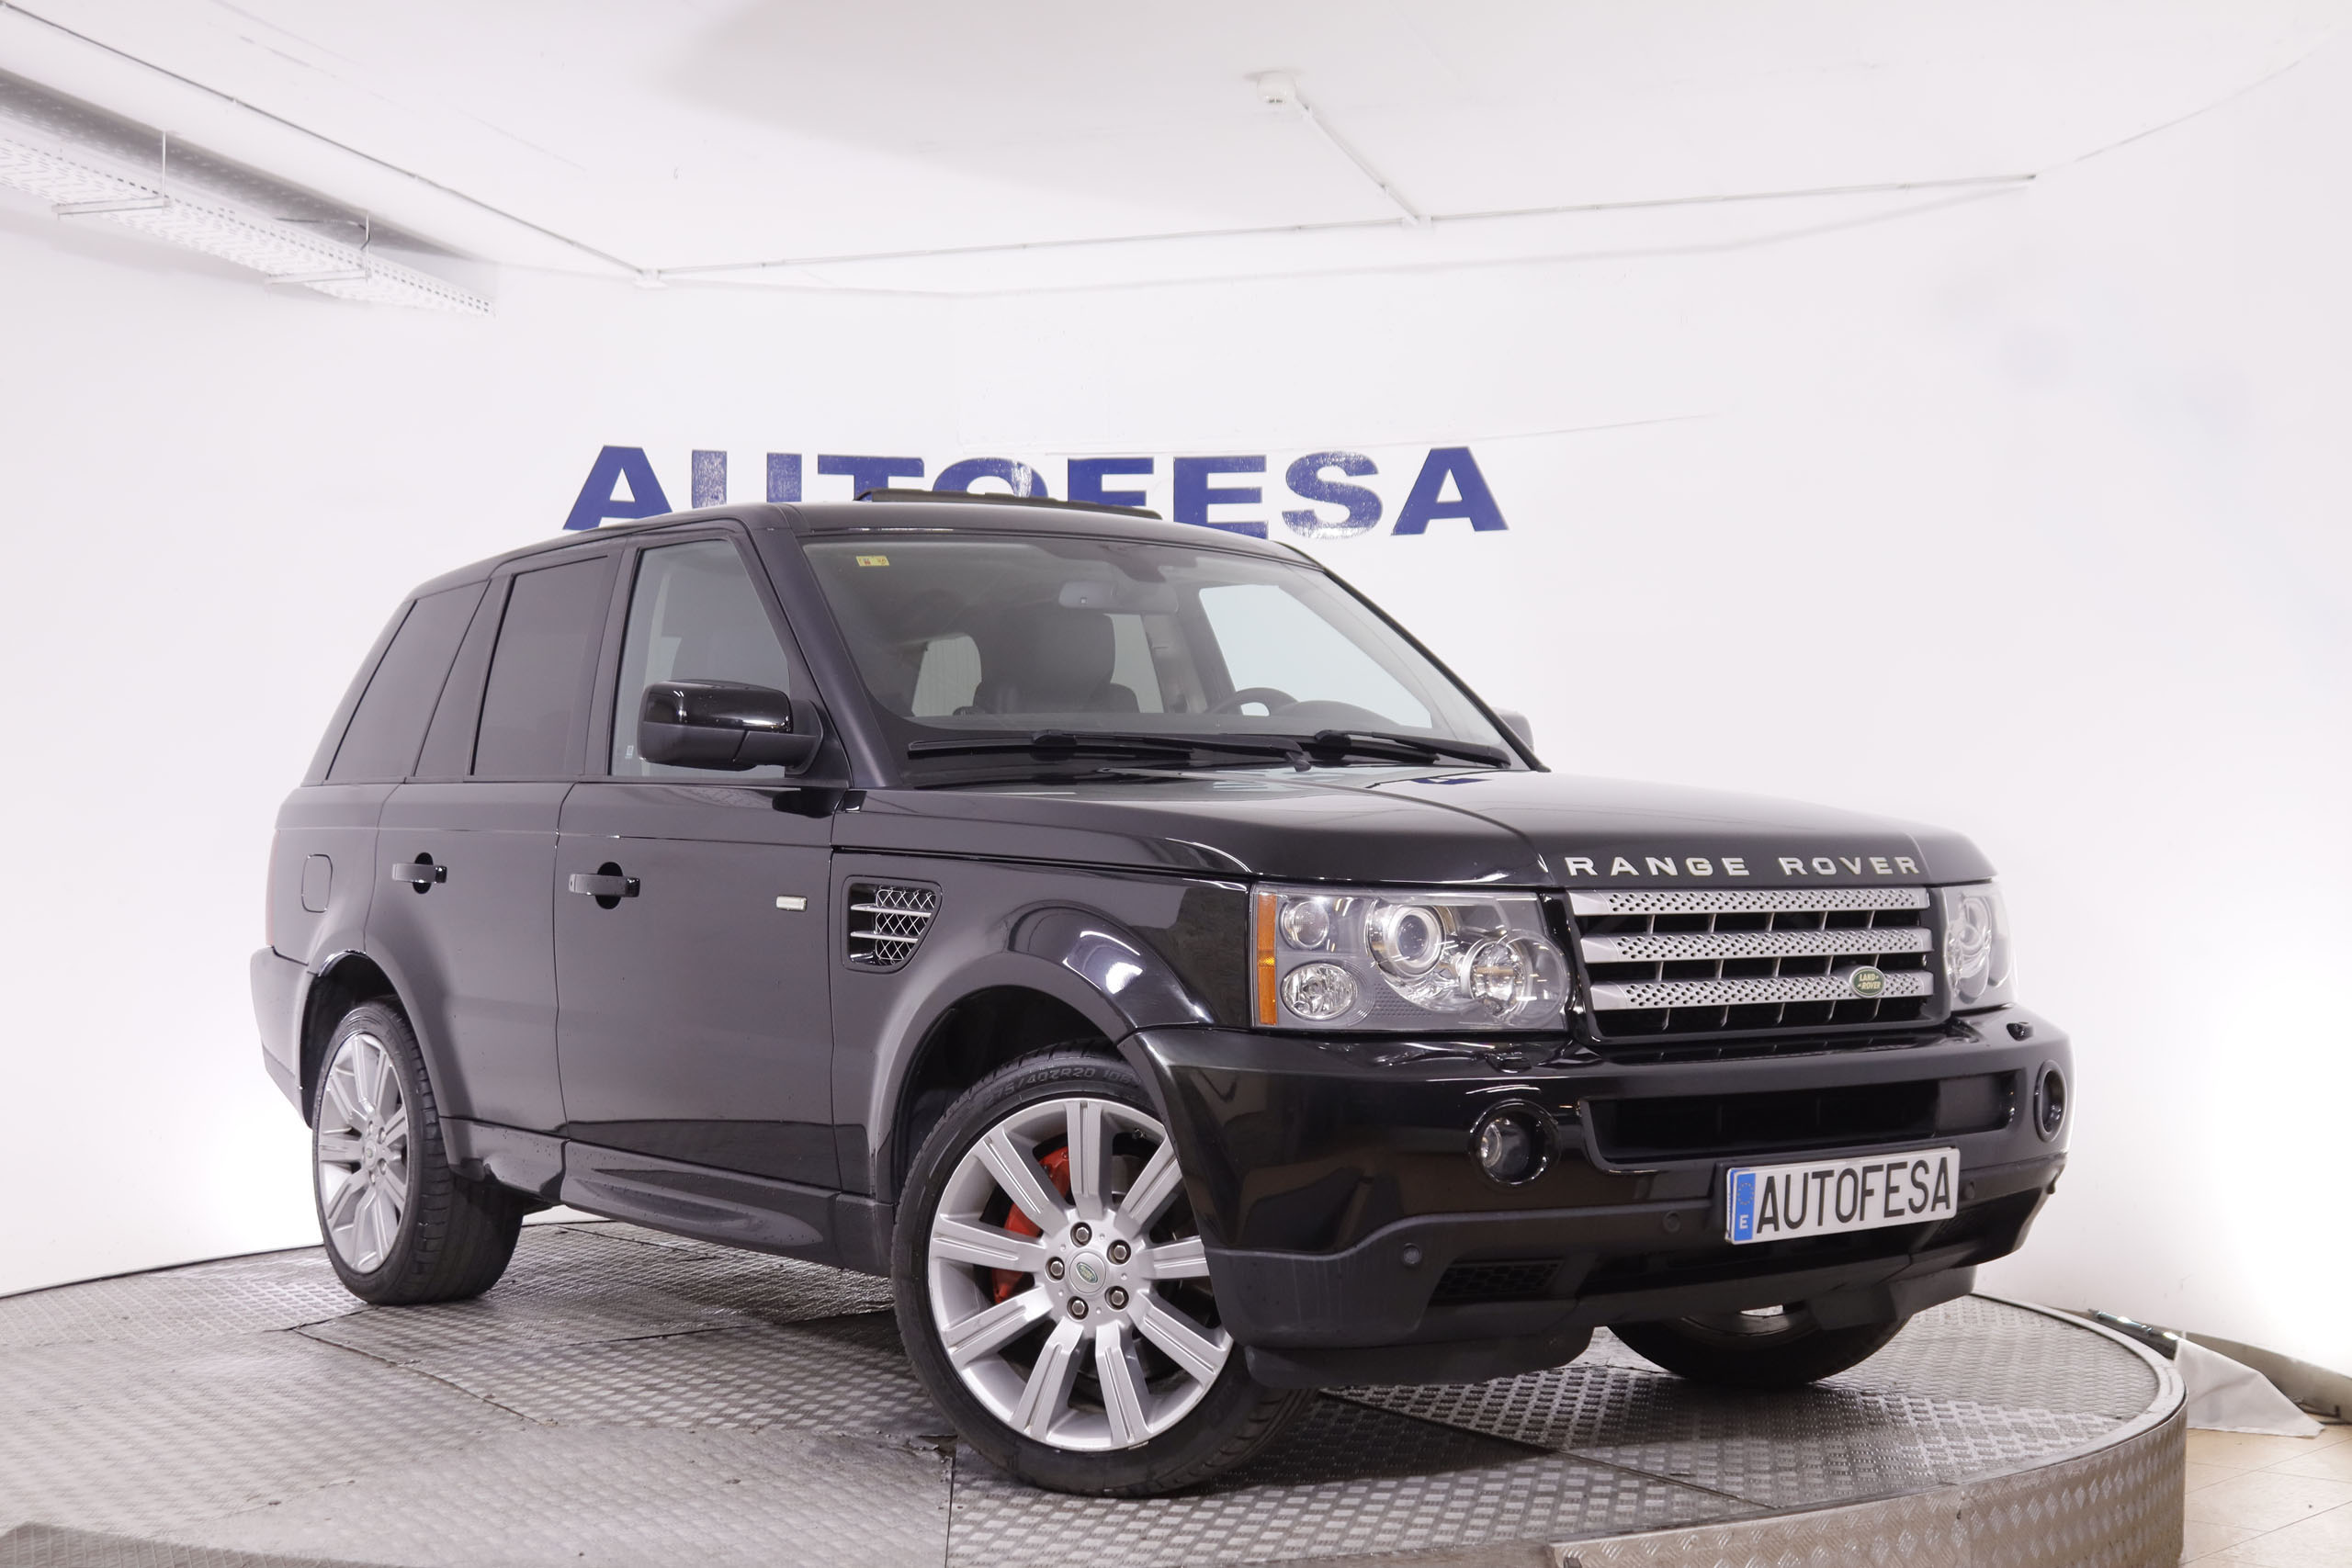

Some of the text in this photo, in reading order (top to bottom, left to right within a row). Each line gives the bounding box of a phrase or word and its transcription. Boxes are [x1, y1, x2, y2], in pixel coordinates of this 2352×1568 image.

[1565, 856, 1920, 876] RANGE ROVER
[1739, 1156, 1951, 1234] E AUTOFESA
